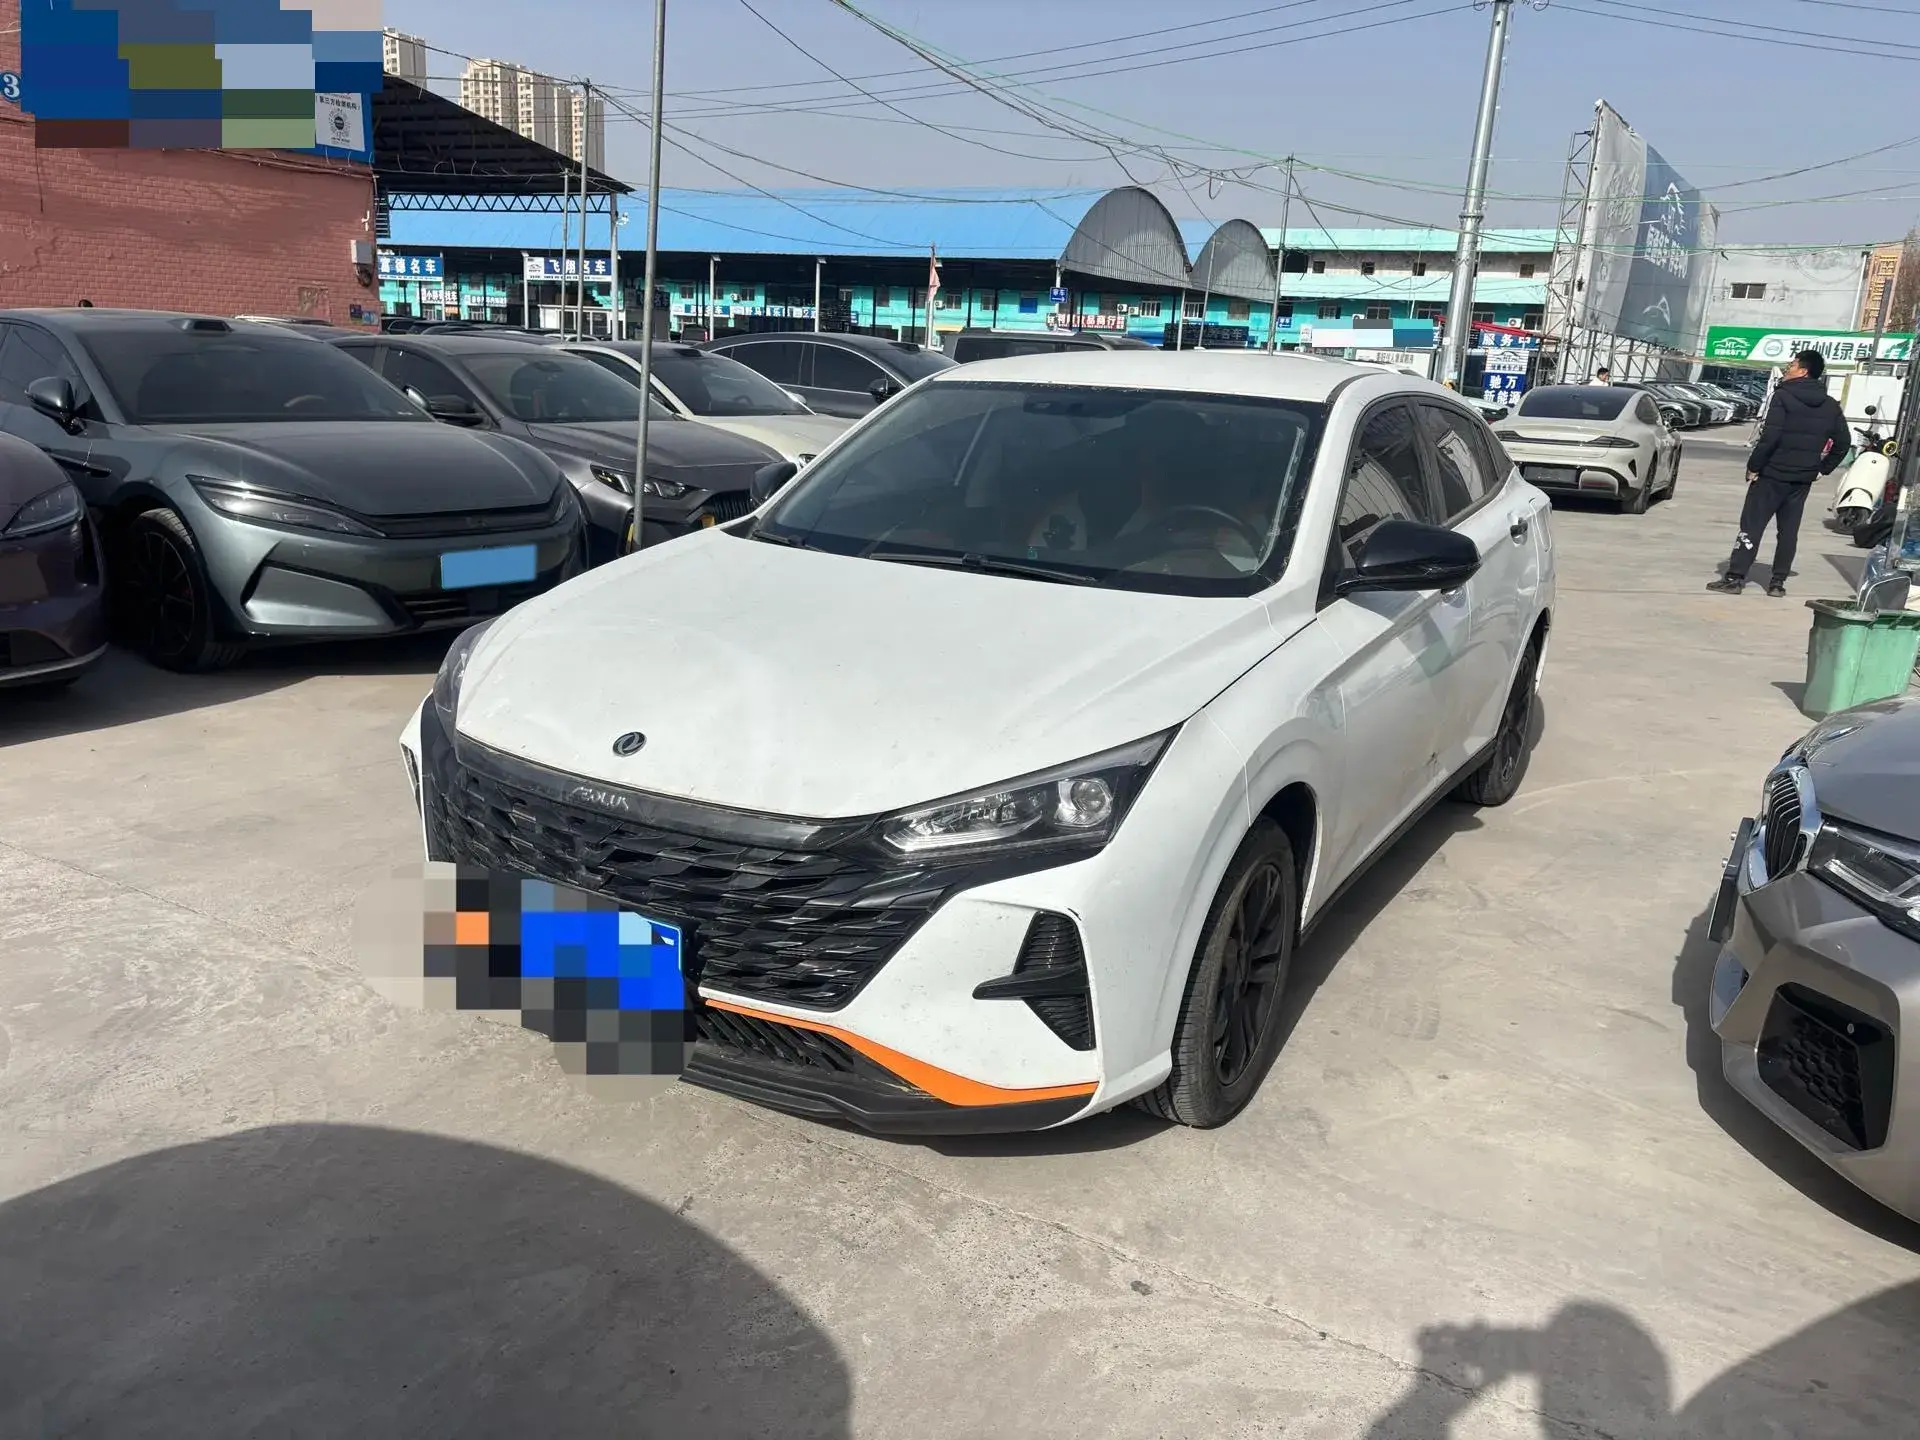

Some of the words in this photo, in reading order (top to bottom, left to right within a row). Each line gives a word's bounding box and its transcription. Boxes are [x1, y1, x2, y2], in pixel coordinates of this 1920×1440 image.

[3, 73, 21, 98] 3
[1482, 333, 1541, 349] 服务中
[1489, 375, 1518, 389] 驰万
[1483, 389, 1522, 405] 新能源
